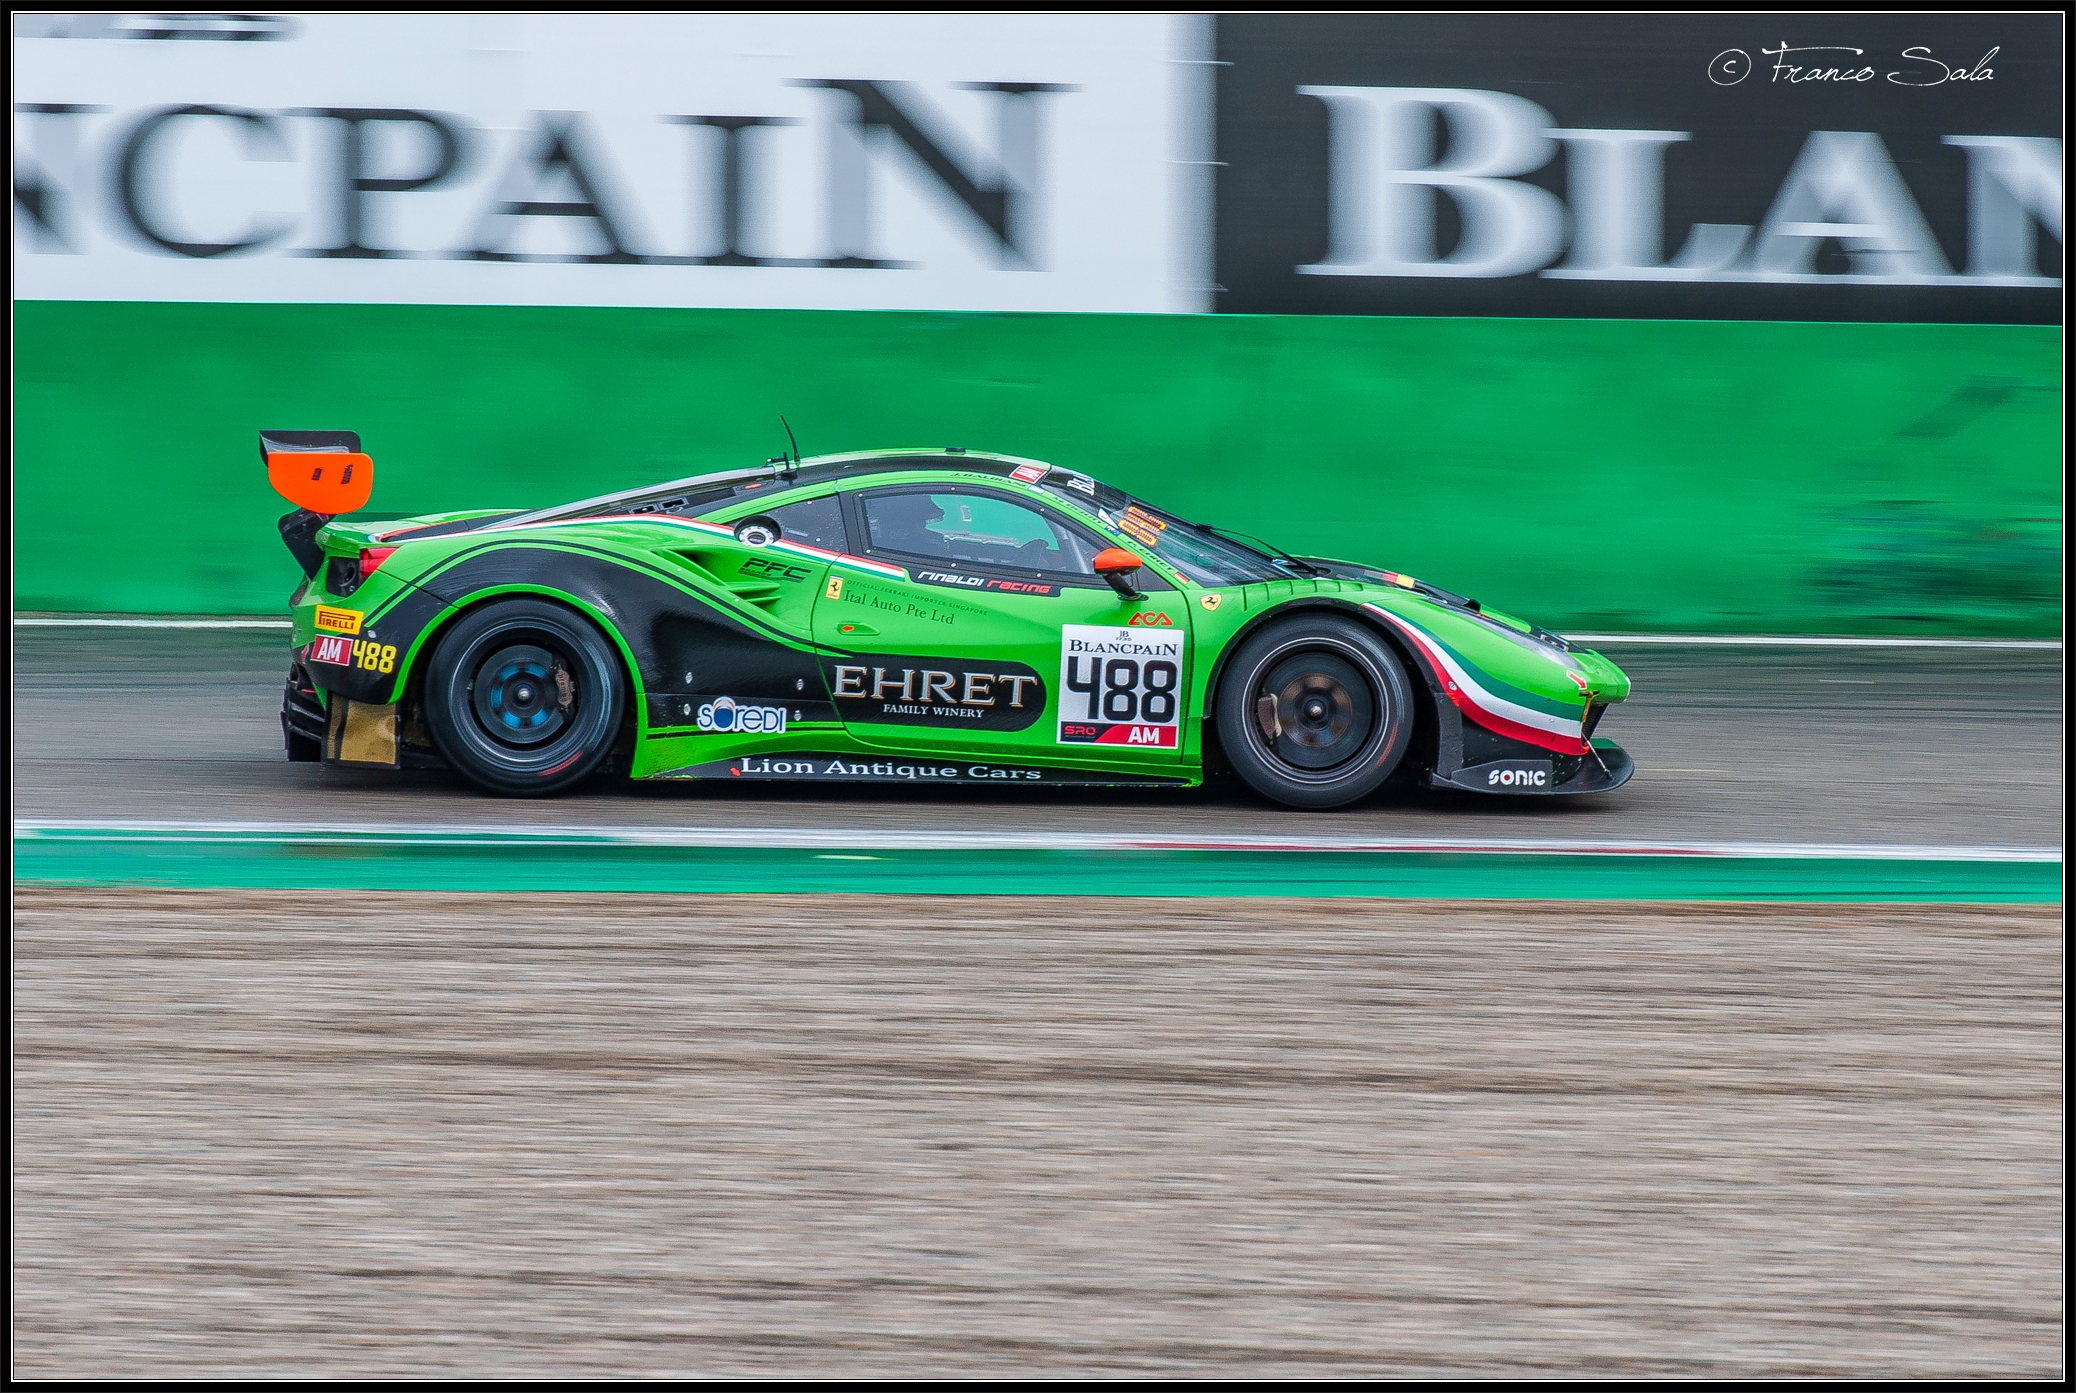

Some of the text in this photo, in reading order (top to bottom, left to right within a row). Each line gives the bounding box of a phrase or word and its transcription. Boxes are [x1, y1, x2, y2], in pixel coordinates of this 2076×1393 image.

[743, 557, 812, 580] PFC
[844, 590, 955, 625] Ital Auto Pte Ltd
[846, 580, 878, 591] OFFICIAL
[880, 587, 909, 597] FERRARI
[948, 602, 988, 616] SINGAPORE
[318, 610, 356, 630] PIRELLI
[1128, 612, 1173, 626] ACA
[317, 638, 342, 662] AM
[353, 640, 397, 674] 488
[1069, 639, 1179, 656] BLANCPAIN
[833, 665, 1038, 708] EHRET
[1067, 656, 1177, 724] 488
[883, 703, 985, 718] FAMILY WINERY
[1064, 725, 1097, 736] SRO
[1127, 727, 1160, 745] AM
[741, 757, 1042, 779] Lion Antique Cars
